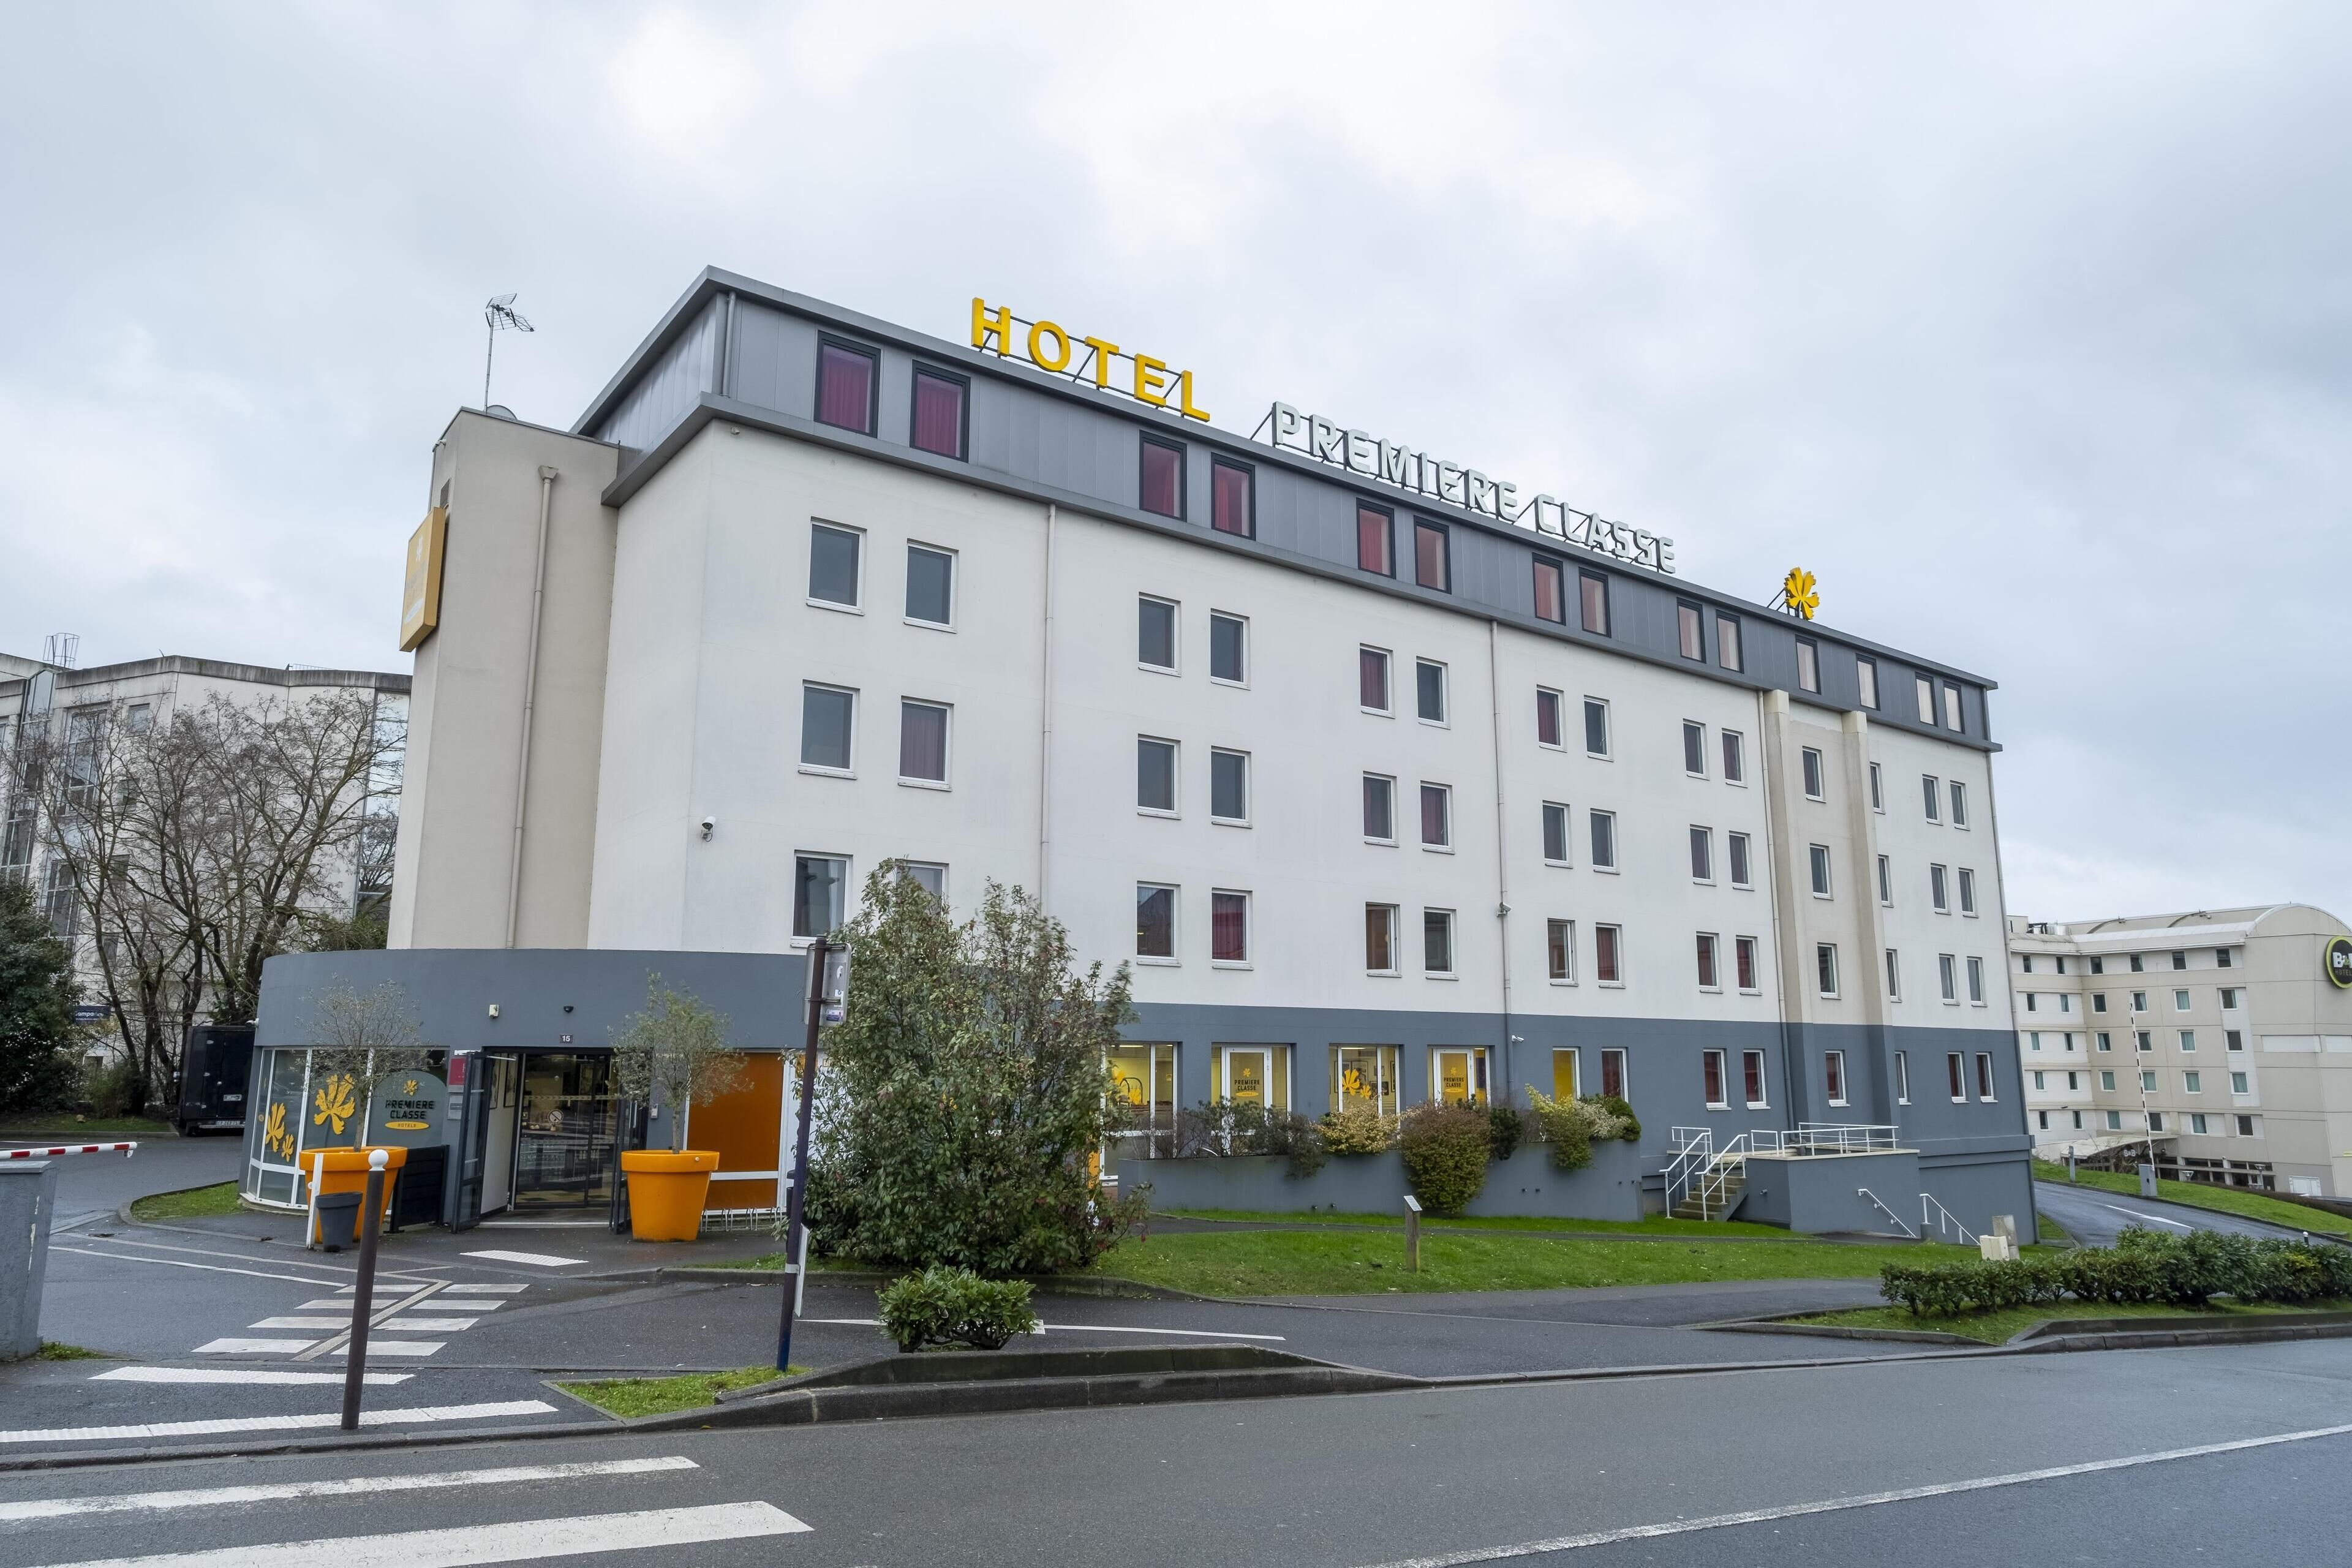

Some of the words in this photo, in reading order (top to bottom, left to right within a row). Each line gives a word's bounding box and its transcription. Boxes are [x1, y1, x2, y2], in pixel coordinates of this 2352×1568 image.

[971, 297, 1210, 423] HOTEL
[1272, 401, 1518, 522] PREMIERE
[1534, 494, 1676, 574] CLASSE
[385, 1100, 435, 1109] PREMIERE
[390, 1110, 426, 1119] CLASSE
